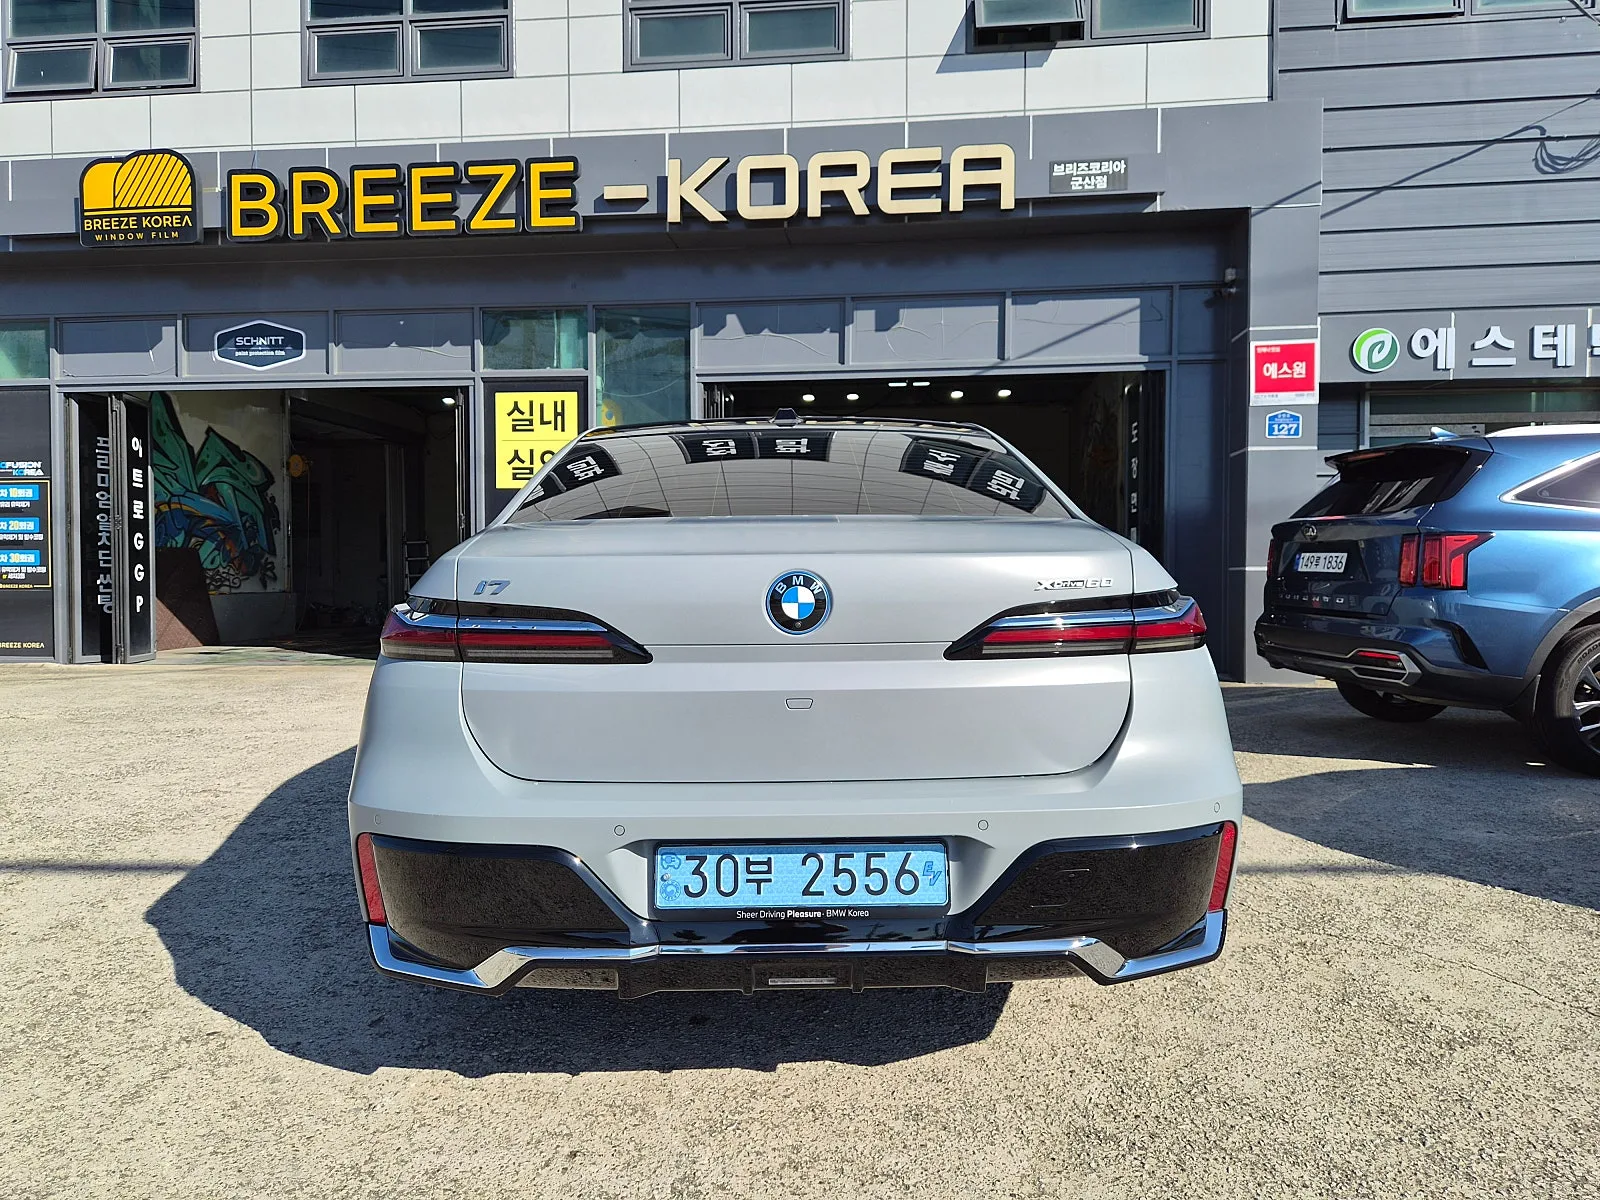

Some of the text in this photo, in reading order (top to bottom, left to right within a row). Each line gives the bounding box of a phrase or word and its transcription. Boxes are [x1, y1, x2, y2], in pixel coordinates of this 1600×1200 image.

[1052, 160, 1127, 176] 브리즈코리아
[231, 159, 578, 238] BREEZE
[667, 142, 1017, 223] KOREA
[1070, 175, 1108, 190] 군산점
[83, 215, 193, 231] BREEZE KOREA
[94, 231, 179, 241] WINDOW FILM
[235, 336, 285, 346] SCHNITT
[1410, 323, 1600, 370] 에스테
[1262, 361, 1306, 379] 에스원
[506, 399, 566, 433] 실내
[1271, 423, 1298, 436] 127
[506, 448, 557, 481] 실
[1322, 555, 1344, 570] 1836
[473, 580, 511, 596] i7
[774, 575, 823, 595] BMW
[683, 854, 773, 899] 30부
[800, 852, 920, 897] 2556
[736, 910, 758, 919] Sheer
[759, 910, 786, 920] Driving
[826, 909, 847, 918] BMW
[848, 909, 870, 917] Korea
